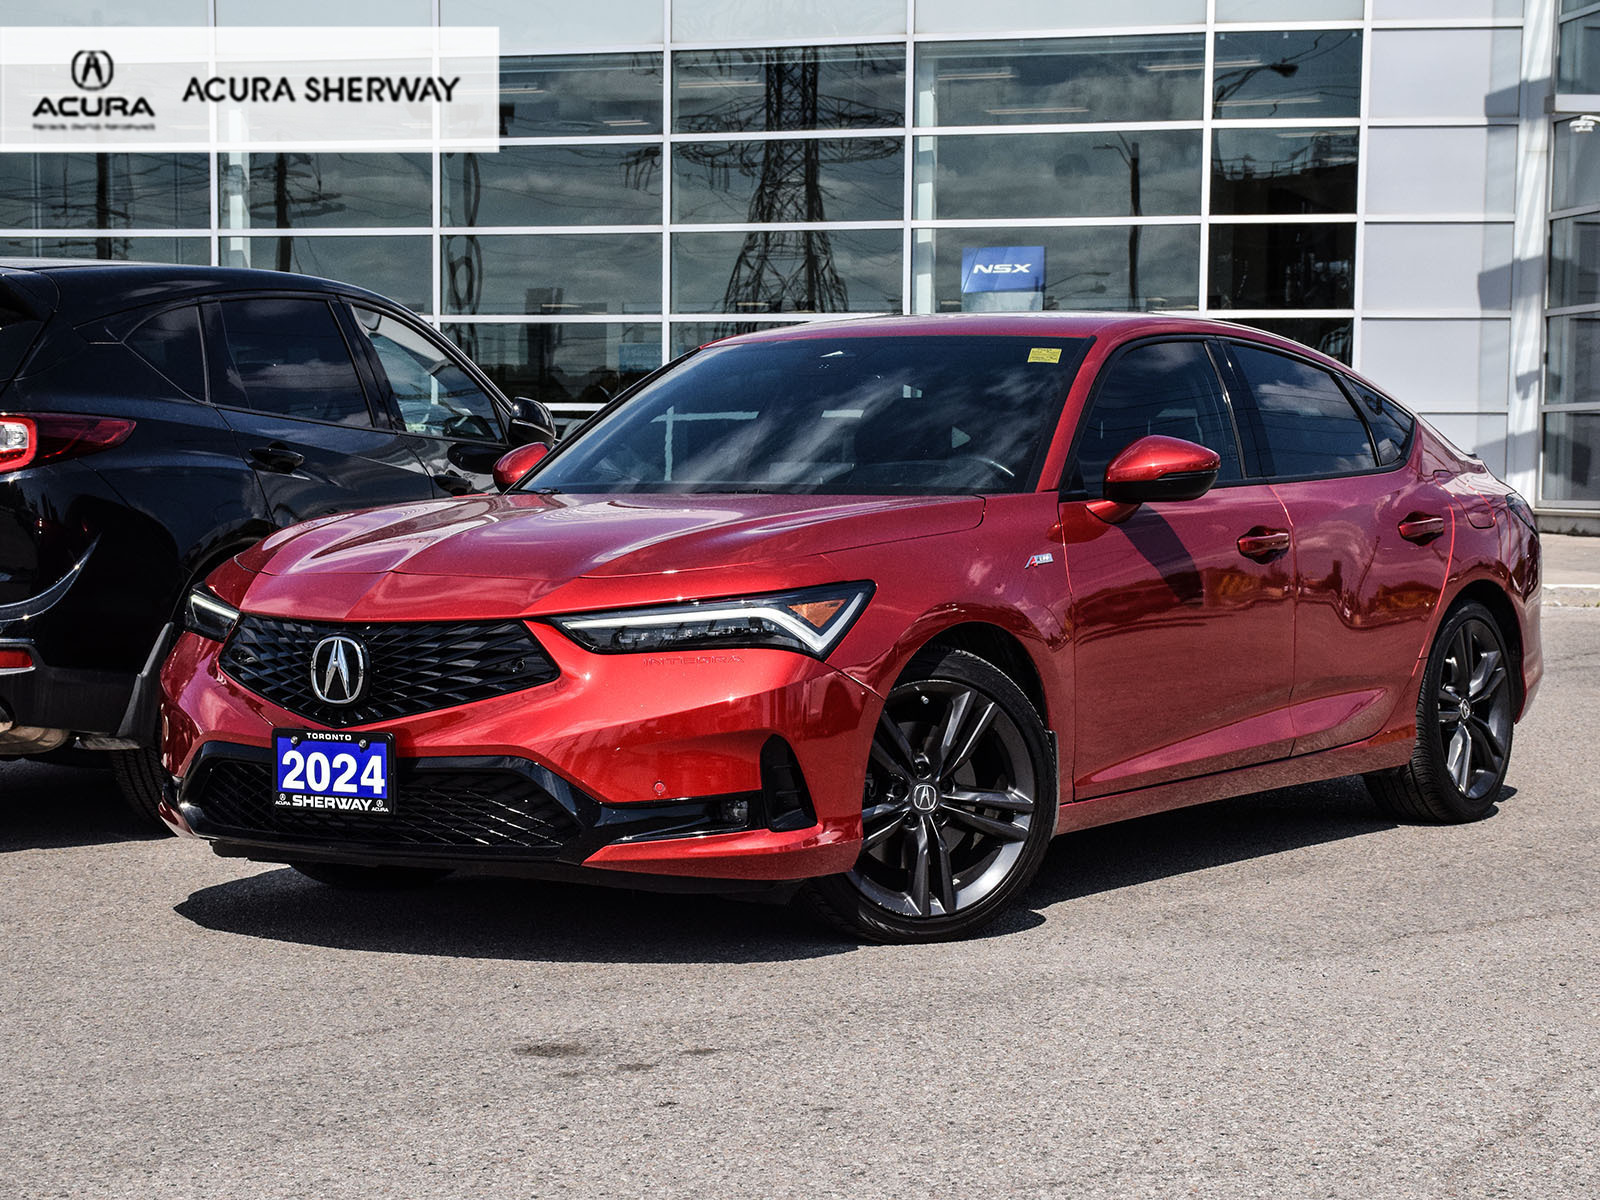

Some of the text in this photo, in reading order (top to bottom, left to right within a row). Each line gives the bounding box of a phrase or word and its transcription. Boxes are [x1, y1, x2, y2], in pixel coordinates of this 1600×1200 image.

[973, 264, 1032, 274] NSX
[644, 655, 744, 666] INTEGRA
[306, 732, 352, 741] TORONTO
[282, 750, 385, 794] 2024
[292, 795, 372, 811] SHERWAY
